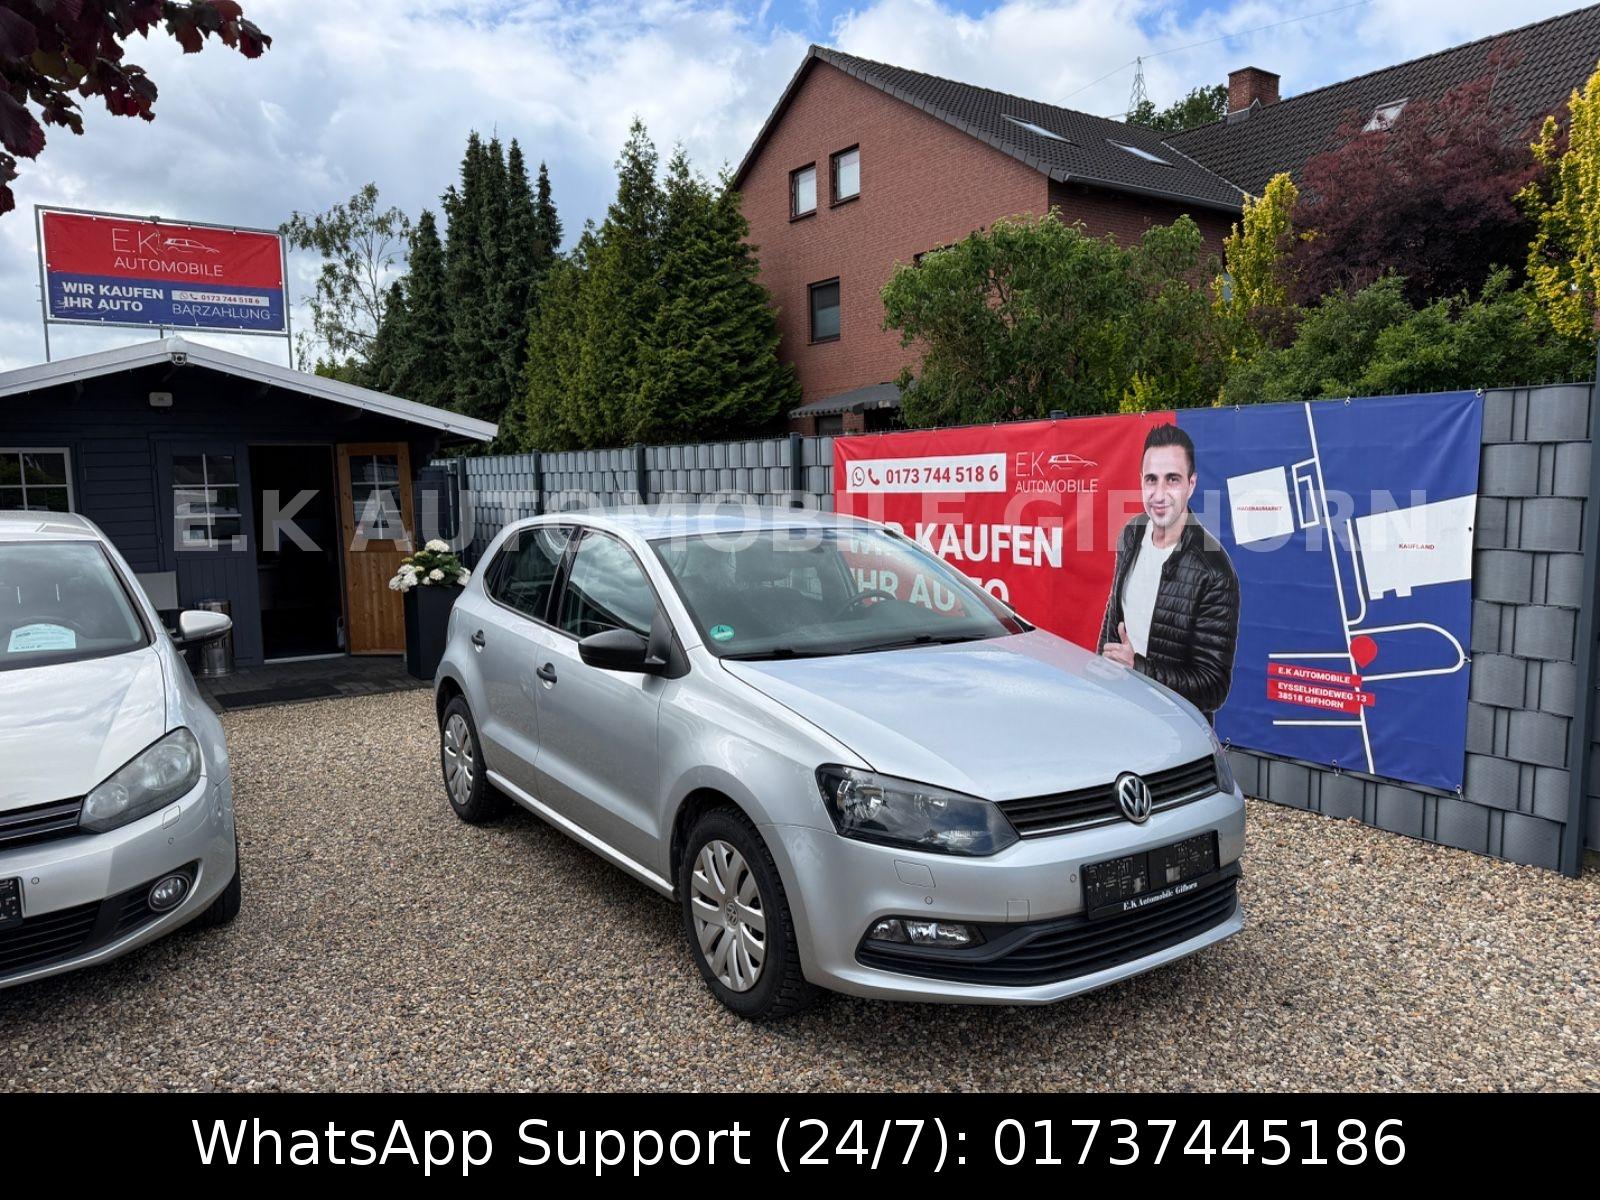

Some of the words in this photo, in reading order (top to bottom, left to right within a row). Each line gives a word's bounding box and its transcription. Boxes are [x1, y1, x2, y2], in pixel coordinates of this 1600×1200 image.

[111, 228, 159, 256] E.K
[113, 256, 224, 278] AUTOMOBILE
[61, 281, 95, 295] WIR
[99, 283, 164, 300] KAUFEN
[200, 294, 221, 302] 0173
[63, 296, 93, 310] IHR
[97, 298, 143, 313] AUTO
[172, 303, 271, 320] BARZAHLUNG
[885, 467, 920, 485] 0173
[924, 466, 951, 483] 744
[956, 465, 985, 483] 518
[988, 464, 999, 482] 6
[1014, 451, 1045, 478] E.K
[1014, 478, 1099, 494] AUTOMOBILE
[914, 522, 1063, 568] KAUFEN
[1398, 543, 1435, 551] KAUFLAND
[908, 573, 1010, 613] AUO
[1277, 666, 1292, 675] E.K
[1293, 669, 1351, 684] AUTOMOBILE
[1277, 682, 1354, 700] EYSSELHEIDEWEG
[1355, 693, 1367, 703] 13
[1277, 690, 1303, 701] 38518
[1304, 695, 1344, 709] GIFHORN
[1138, 888, 1174, 907] Automobile
[1175, 881, 1198, 896] Gifhorn
